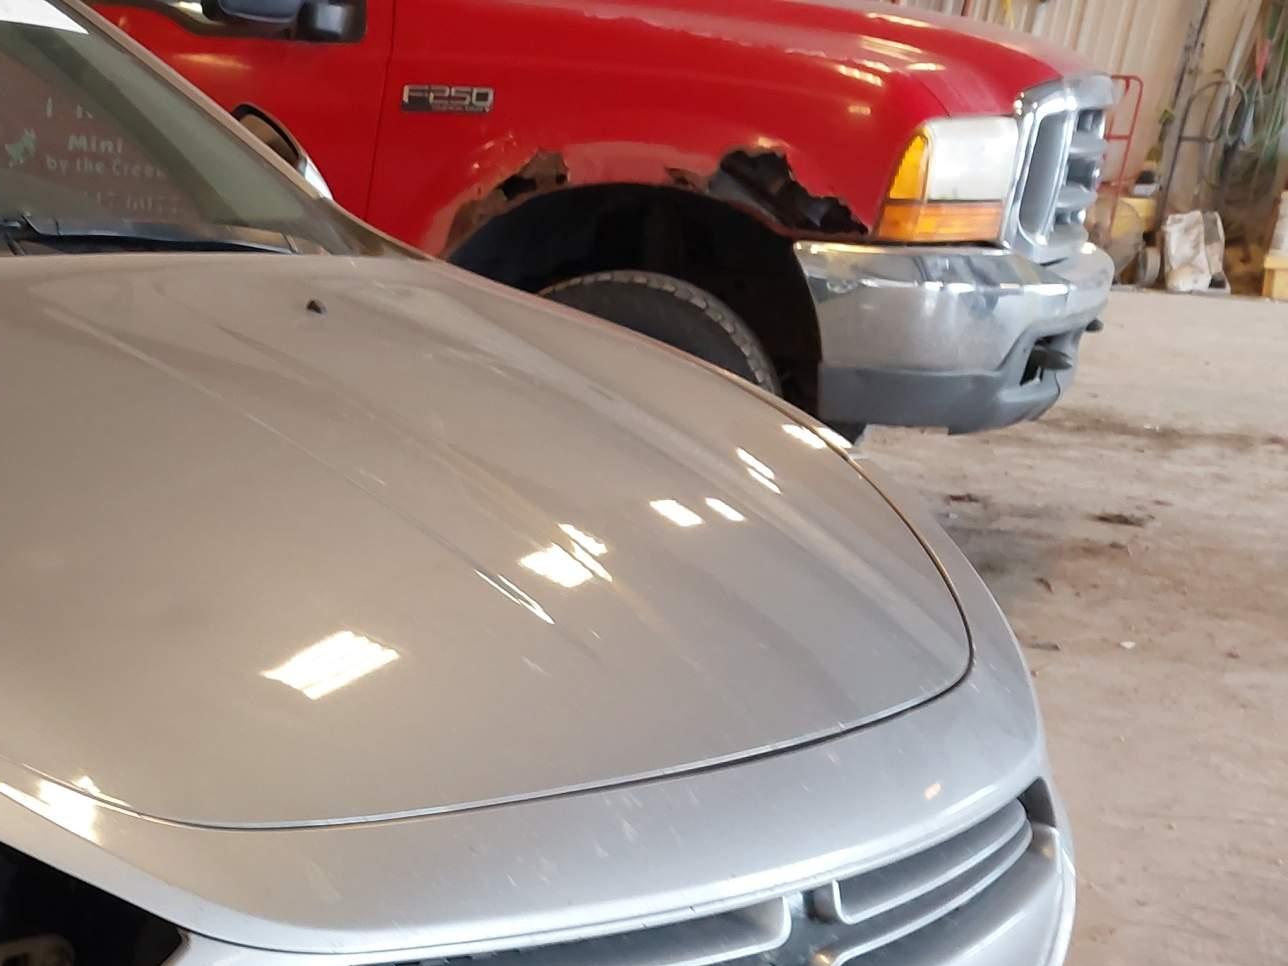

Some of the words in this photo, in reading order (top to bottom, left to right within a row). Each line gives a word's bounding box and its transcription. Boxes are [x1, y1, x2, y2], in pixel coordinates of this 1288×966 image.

[402, 84, 494, 107] F250
[67, 134, 123, 153] Mini
[45, 154, 69, 176] by
[75, 156, 105, 175] the
